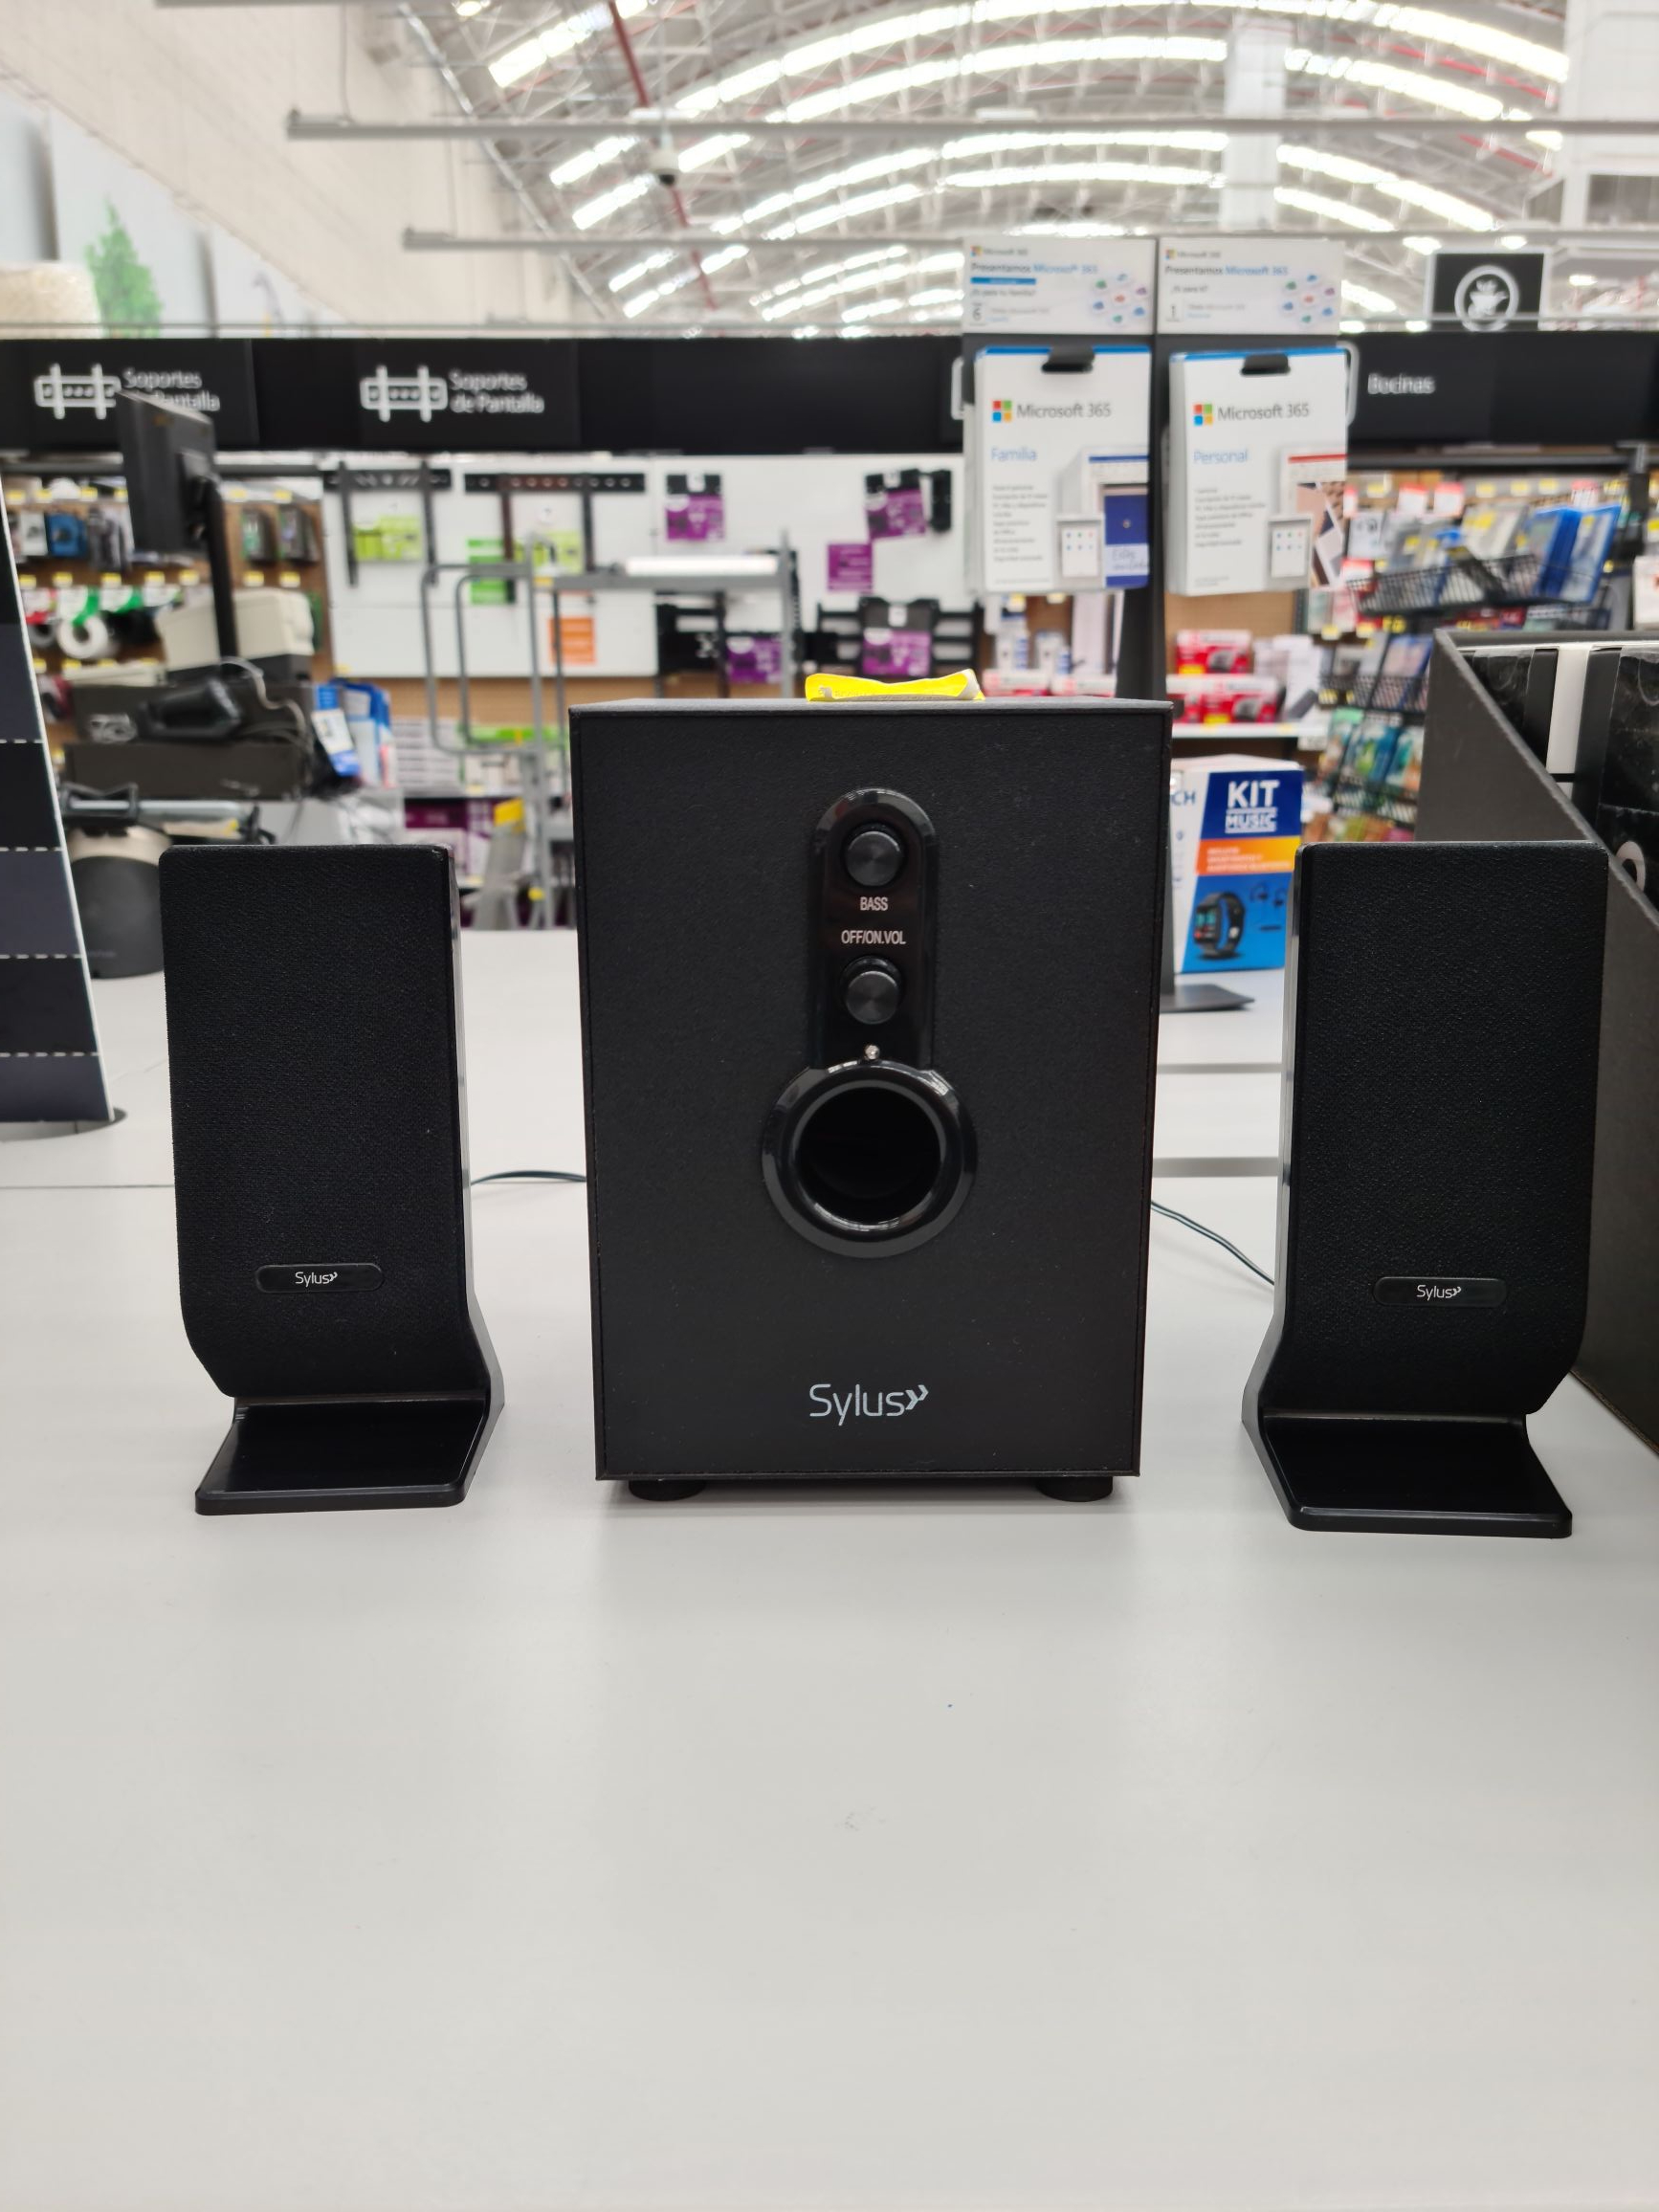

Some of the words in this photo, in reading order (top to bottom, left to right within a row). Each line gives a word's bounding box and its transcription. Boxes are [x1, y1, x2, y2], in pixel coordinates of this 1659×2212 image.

[122, 368, 203, 391] Soportes
[448, 369, 528, 393] Soportes
[1367, 373, 1435, 394] Bocinas
[450, 393, 475, 413] de
[476, 392, 544, 413] Pantalla
[1016, 403, 1083, 419] Microsoft
[1087, 403, 1112, 418] 365
[1217, 405, 1283, 421] Microsoft
[1287, 403, 1310, 418] 365
[991, 448, 1037, 461] Familia
[1193, 450, 1249, 465] Personal
[1228, 780, 1280, 807] KIT
[1226, 812, 1276, 829] MUSIC
[860, 896, 889, 911] BASS
[841, 930, 906, 944] OFF/ON.VOL
[295, 1272, 330, 1287] Sylus
[1416, 1284, 1453, 1301] Sylus
[809, 1383, 905, 1426] Sylus
